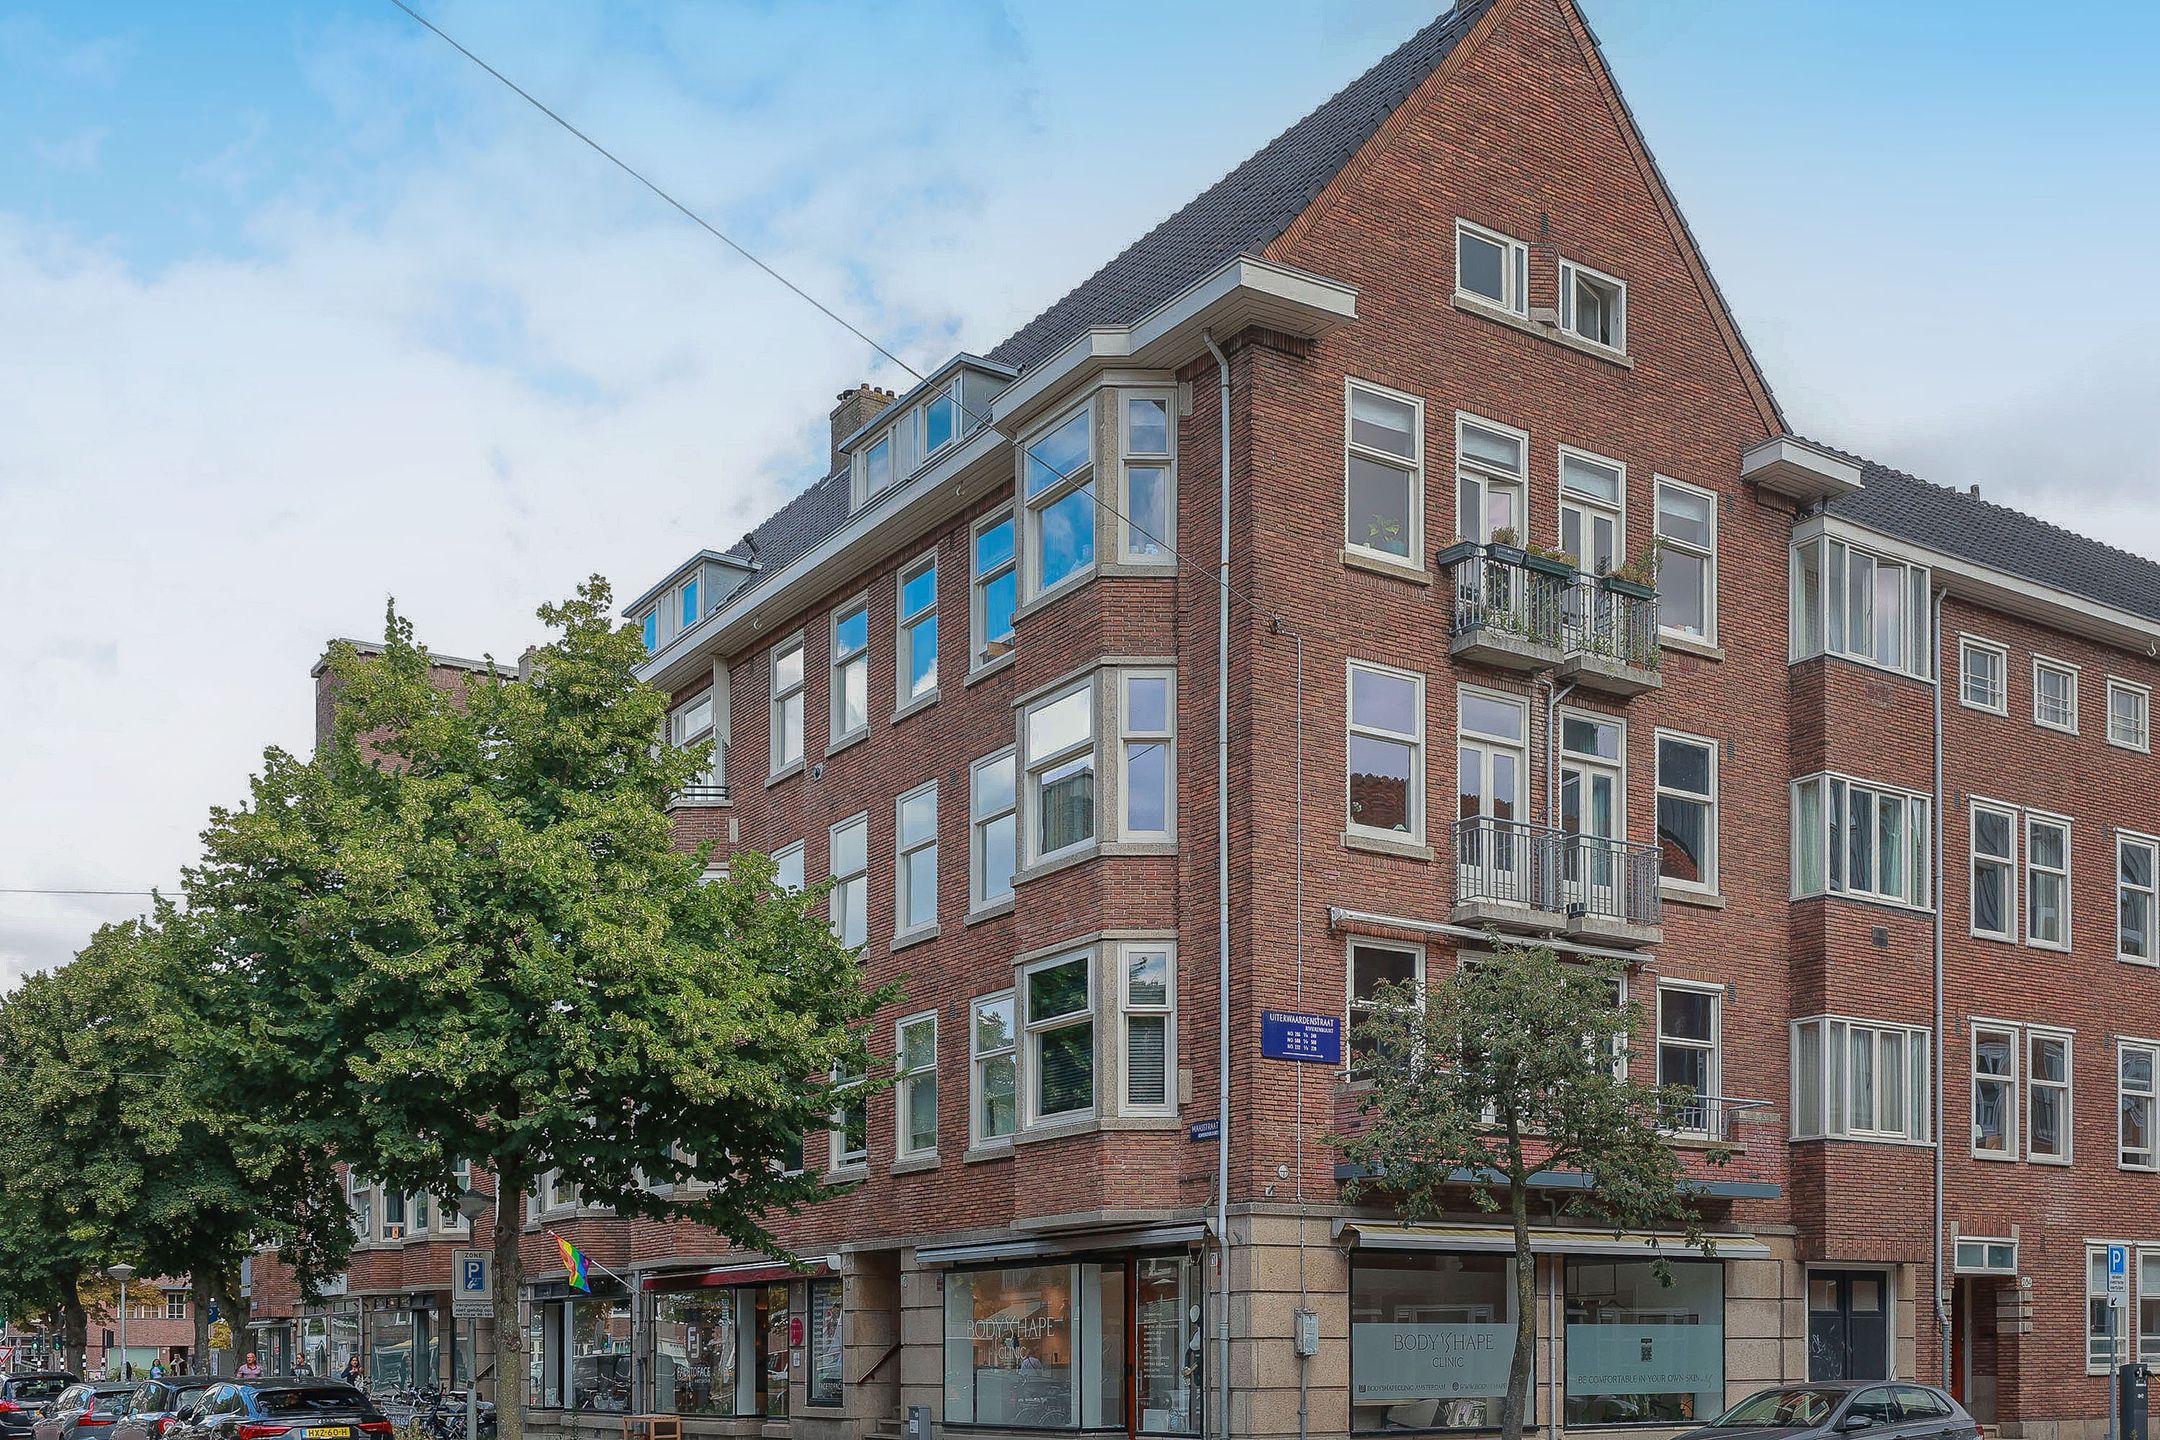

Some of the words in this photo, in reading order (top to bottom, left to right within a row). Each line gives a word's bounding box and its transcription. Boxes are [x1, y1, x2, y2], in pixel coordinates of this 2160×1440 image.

[1269, 1013, 1334, 1027] UITERWAARDENSTRAAT
[2113, 1250, 2121, 1271] P
[468, 1262, 480, 1278] P
[998, 1346, 1027, 1359] CLINIC
[1432, 1356, 1464, 1368] CLINIC
[1578, 1375, 1587, 1384] BE
[1588, 1374, 1637, 1384] COMFORTABLE
[1638, 1374, 1646, 1383] IN
[1647, 1374, 1666, 1383] YOUR
[1667, 1374, 1684, 1383] OWN
[308, 1429, 347, 1437] HXZ-60-H
